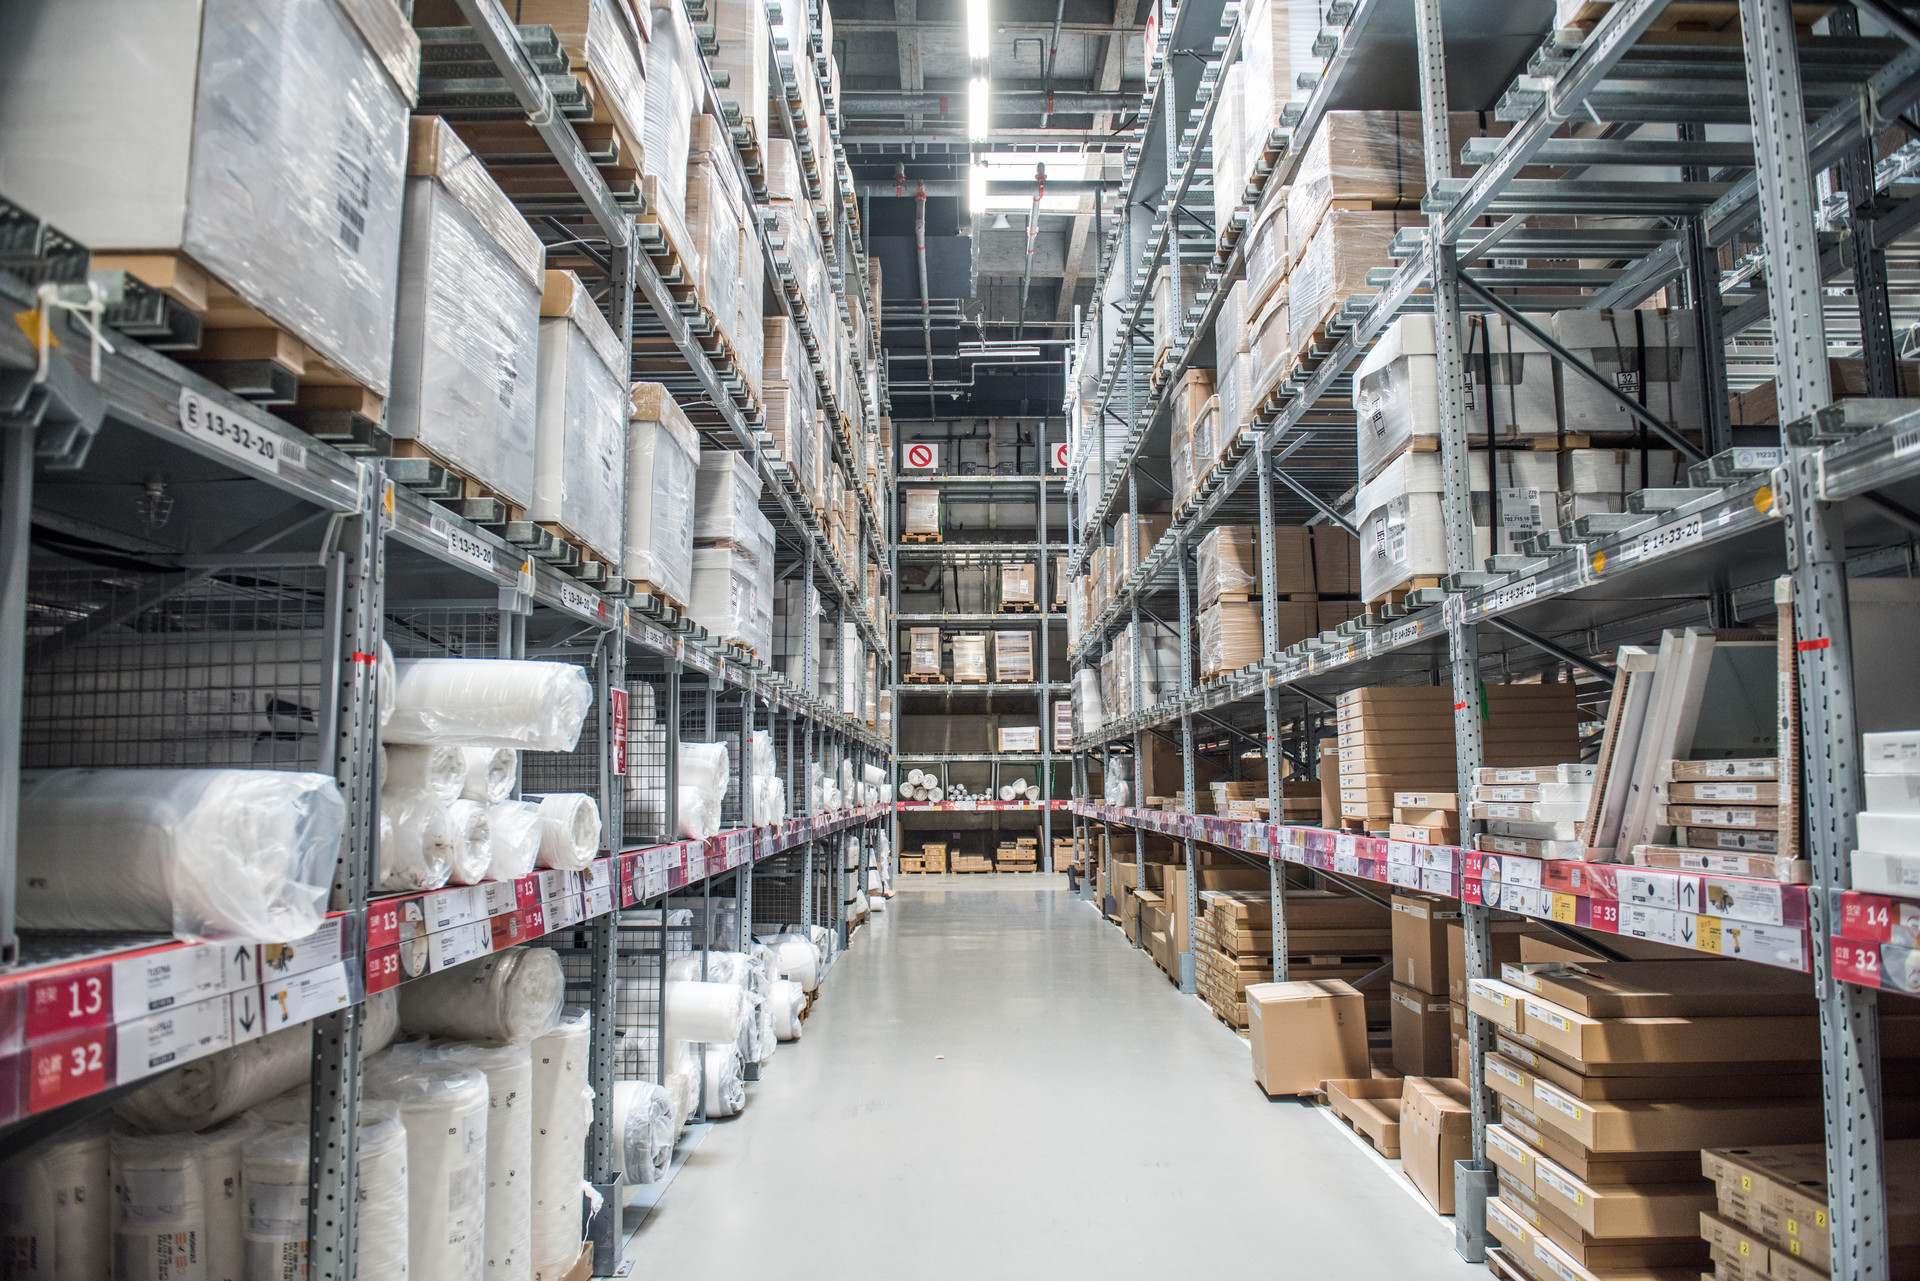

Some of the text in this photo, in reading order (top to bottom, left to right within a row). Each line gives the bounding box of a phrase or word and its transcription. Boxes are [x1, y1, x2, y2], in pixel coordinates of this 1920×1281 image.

[1621, 374, 1633, 383] 32
[187, 402, 275, 460] E 13-32-20
[1643, 520, 1700, 553] E 14-33-20
[451, 532, 492, 564] E 13-33-20
[563, 588, 590, 610] E 13-34-20
[1499, 582, 1535, 604] E 14-34-20
[1381, 844, 1387, 854] 14
[1380, 865, 1387, 875] 35
[1473, 858, 1481, 870] 14
[524, 880, 534, 896] 13
[1472, 883, 1481, 896] 34
[1604, 875, 1617, 890] 14
[383, 911, 398, 931] 13
[532, 911, 543, 927] 34
[1603, 906, 1617, 922] 33
[1867, 905, 1889, 928] 14
[383, 953, 399, 974] 33
[1855, 948, 1878, 972] 32
[68, 977, 103, 1018] 13
[70, 1042, 103, 1076] 32
[1743, 1178, 1750, 1189] 2
[1790, 1222, 1795, 1231] 1
[1818, 1214, 1824, 1224] 2
[1742, 1244, 1748, 1254] 2
